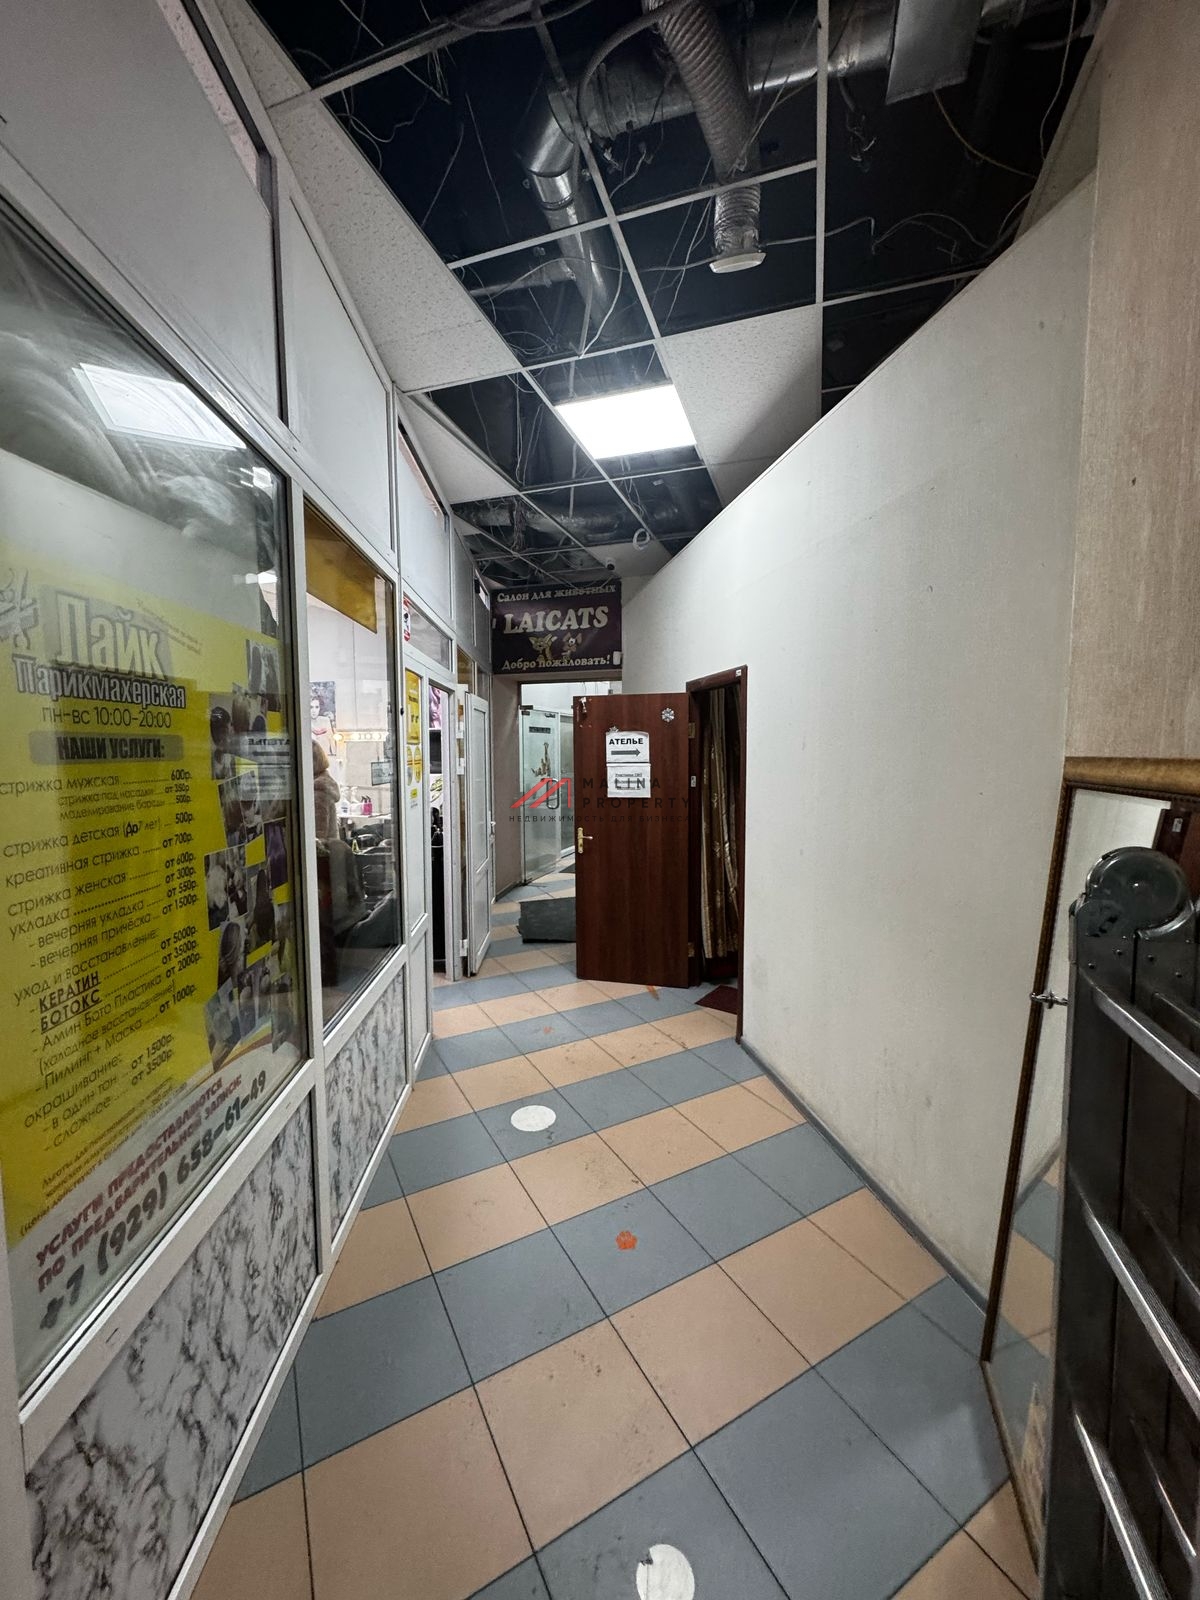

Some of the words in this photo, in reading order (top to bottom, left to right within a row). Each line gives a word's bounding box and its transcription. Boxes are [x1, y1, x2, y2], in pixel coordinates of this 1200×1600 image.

[497, 592, 529, 602] Салон
[531, 590, 552, 600] для
[554, 584, 616, 598] животных
[53, 591, 168, 681] Лайк
[503, 606, 609, 634] LAICATS
[13, 654, 186, 709] Парикмахерская
[502, 658, 538, 670] Добро
[538, 654, 610, 668] пожаловать!
[94, 707, 172, 728] 10:00-20:00
[56, 736, 107, 760] НАШИ
[109, 737, 165, 759] УСЛУГИ:
[0, 780, 62, 797] стрижка
[66, 775, 120, 791] мужская
[3, 834, 69, 858] стрижка
[72, 826, 120, 845] детская
[5, 857, 89, 889] креативная
[92, 846, 140, 866] стрижка
[162, 838, 172, 848] от
[7, 887, 71, 917] стрижка
[74, 872, 127, 897] женская
[164, 858, 174, 869] от
[8, 907, 70, 940] укладка
[165, 873, 175, 884] от
[38, 917, 97, 948] вечерняя
[100, 900, 145, 926] укладка
[166, 887, 176, 898] от
[39, 937, 99, 968] вечерняя
[161, 905, 172, 916] от
[13, 981, 50, 1007] уход
[54, 975, 62, 985] и
[39, 970, 100, 1012] КЕРАТИН
[160, 939, 171, 950] от
[40, 989, 101, 1032] БОТОКС
[161, 954, 172, 965] от
[115, 974, 162, 1008] Пластика
[166, 967, 176, 978] от
[159, 1001, 170, 1014] от
[24, 1053, 122, 1128] окрашивание:
[98, 1076, 118, 1094] тон
[131, 1054, 144, 1069] от
[53, 1095, 111, 1148] сложное
[131, 1071, 144, 1086] от
[98, 1171, 168, 1276] (929)
[176, 1070, 266, 1185] 658-61-49
[36, 1192, 104, 1267] УСЛУГИ
[38, 1255, 66, 1293] ПО
